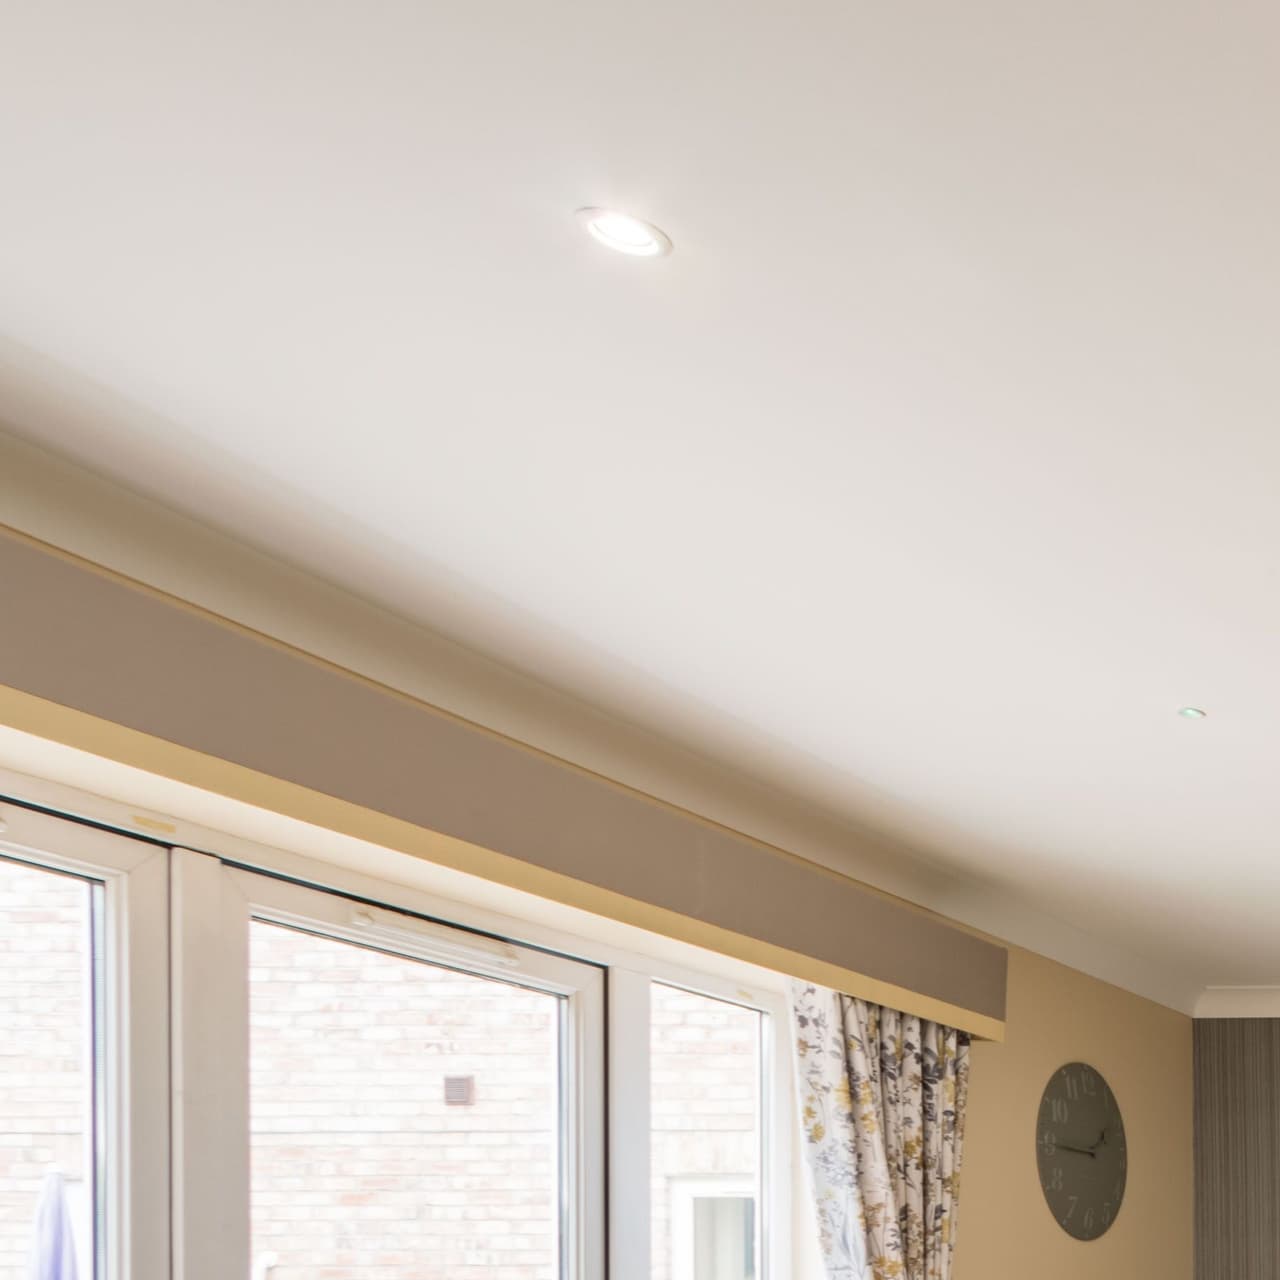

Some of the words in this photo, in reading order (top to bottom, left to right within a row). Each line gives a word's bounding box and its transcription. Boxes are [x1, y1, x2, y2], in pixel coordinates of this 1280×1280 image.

[1051, 1098, 1069, 1125] 10
[1051, 1167, 1064, 1193] 8
[1067, 1195, 1080, 1220] 7
[1083, 1207, 1096, 1230] 6
